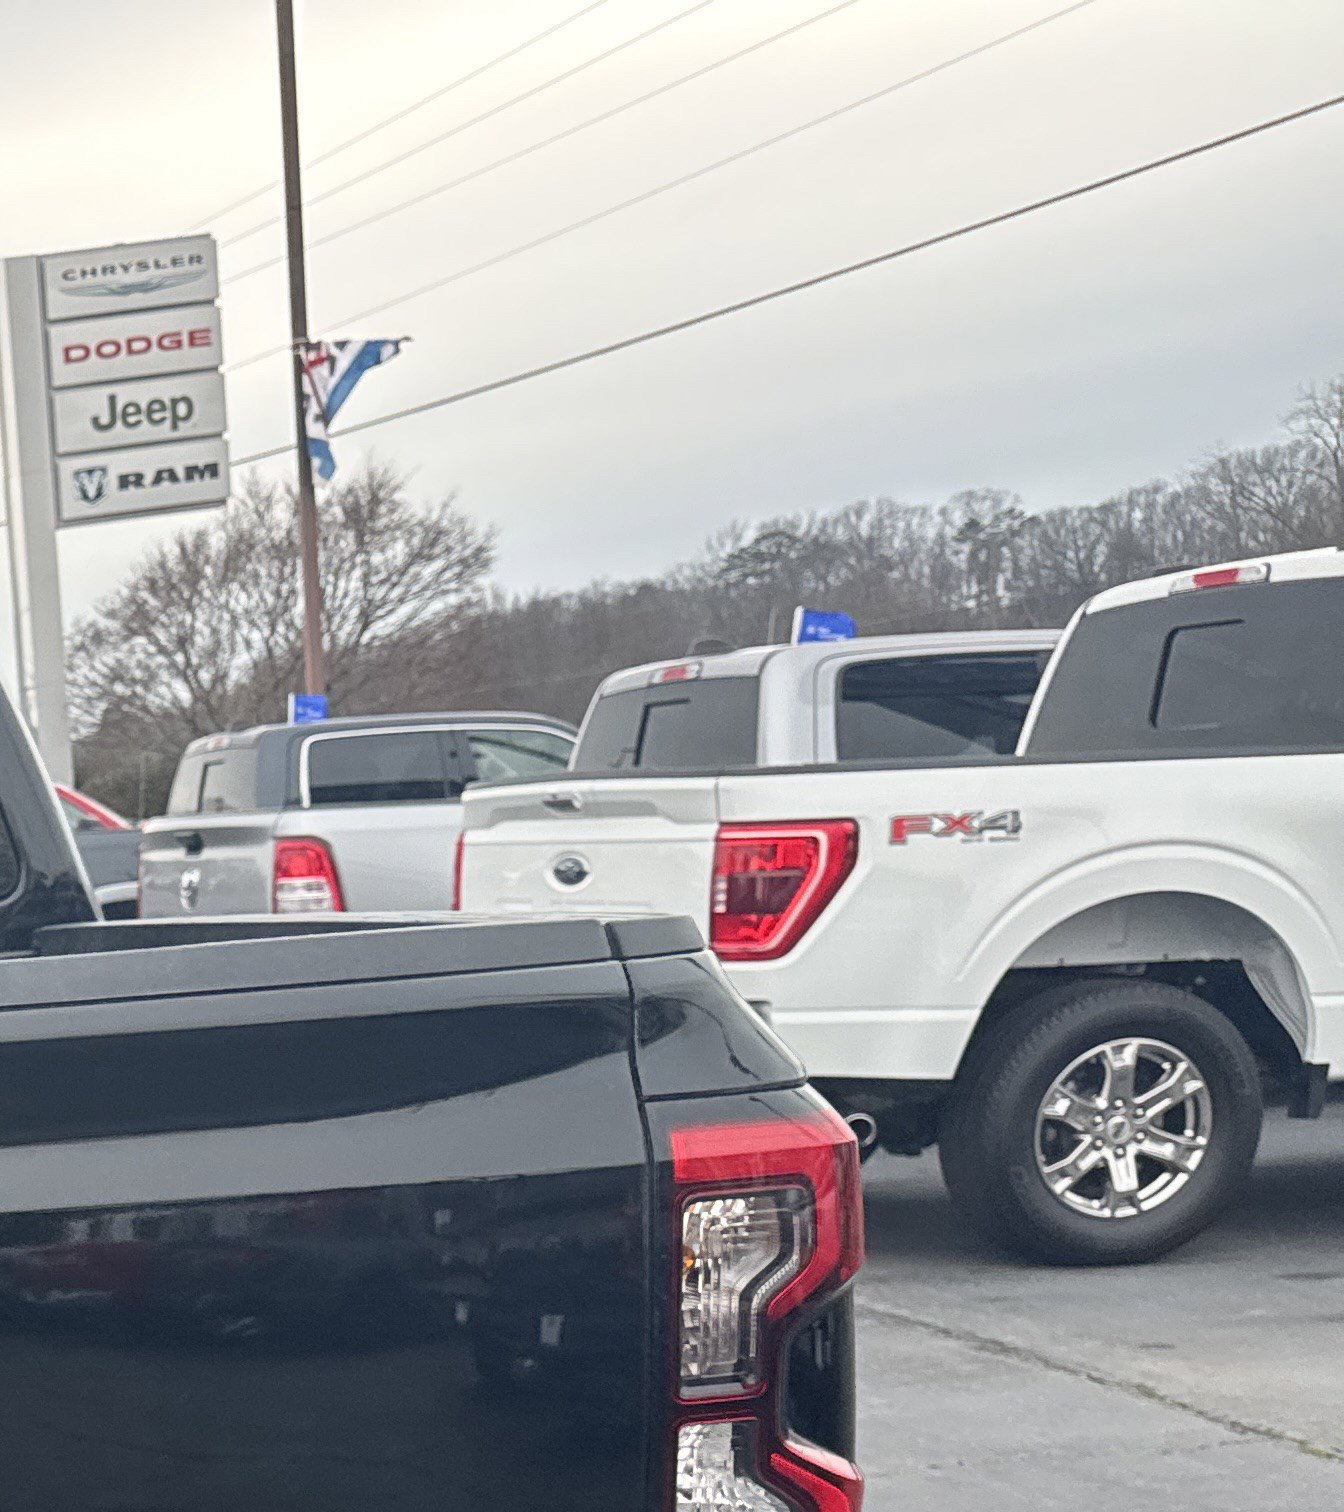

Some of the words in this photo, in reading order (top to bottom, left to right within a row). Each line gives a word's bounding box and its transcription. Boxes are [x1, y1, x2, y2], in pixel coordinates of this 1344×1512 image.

[62, 253, 204, 282] CHRYSLER
[63, 327, 214, 365] DODGE
[91, 392, 194, 432] Jeep
[117, 462, 219, 492] RAM
[889, 809, 1022, 845] FX4
